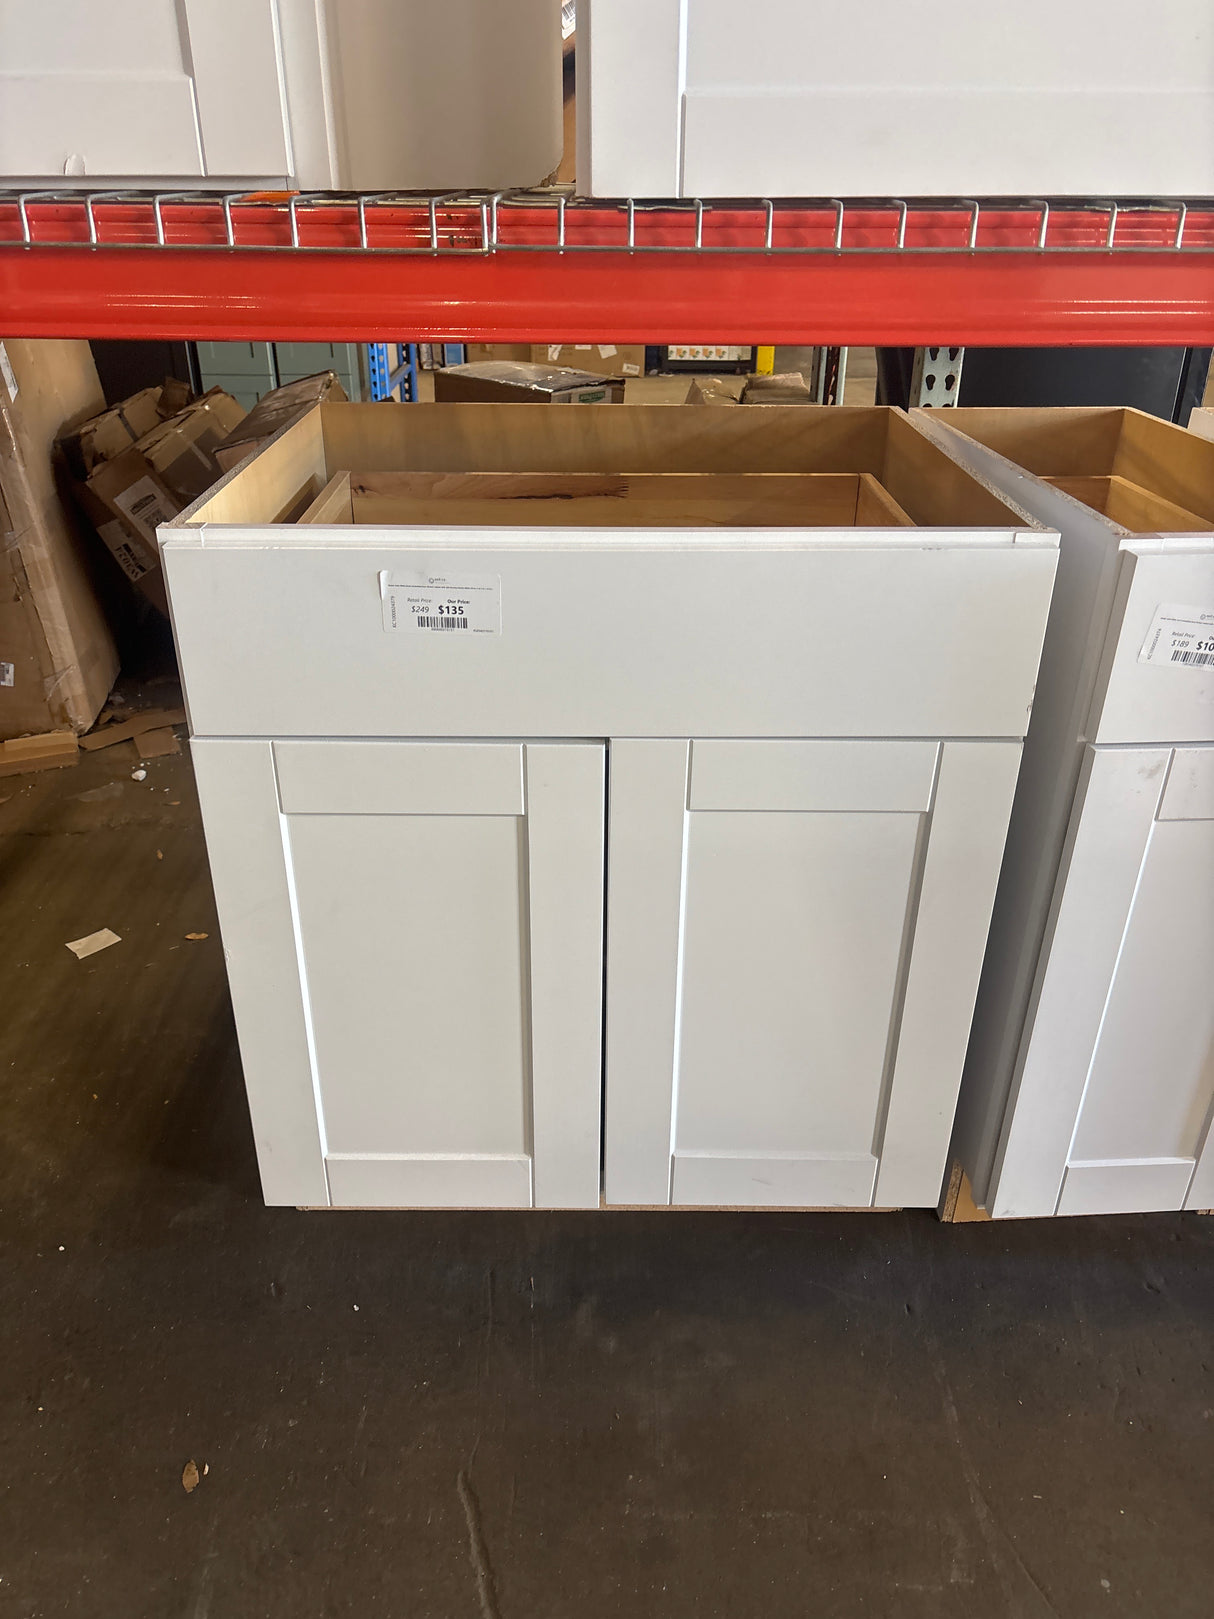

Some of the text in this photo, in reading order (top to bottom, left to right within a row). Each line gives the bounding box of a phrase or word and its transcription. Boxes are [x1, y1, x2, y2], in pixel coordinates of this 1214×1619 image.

[411, 605, 464, 615] $249 $135
[1171, 639, 1190, 648] $189
